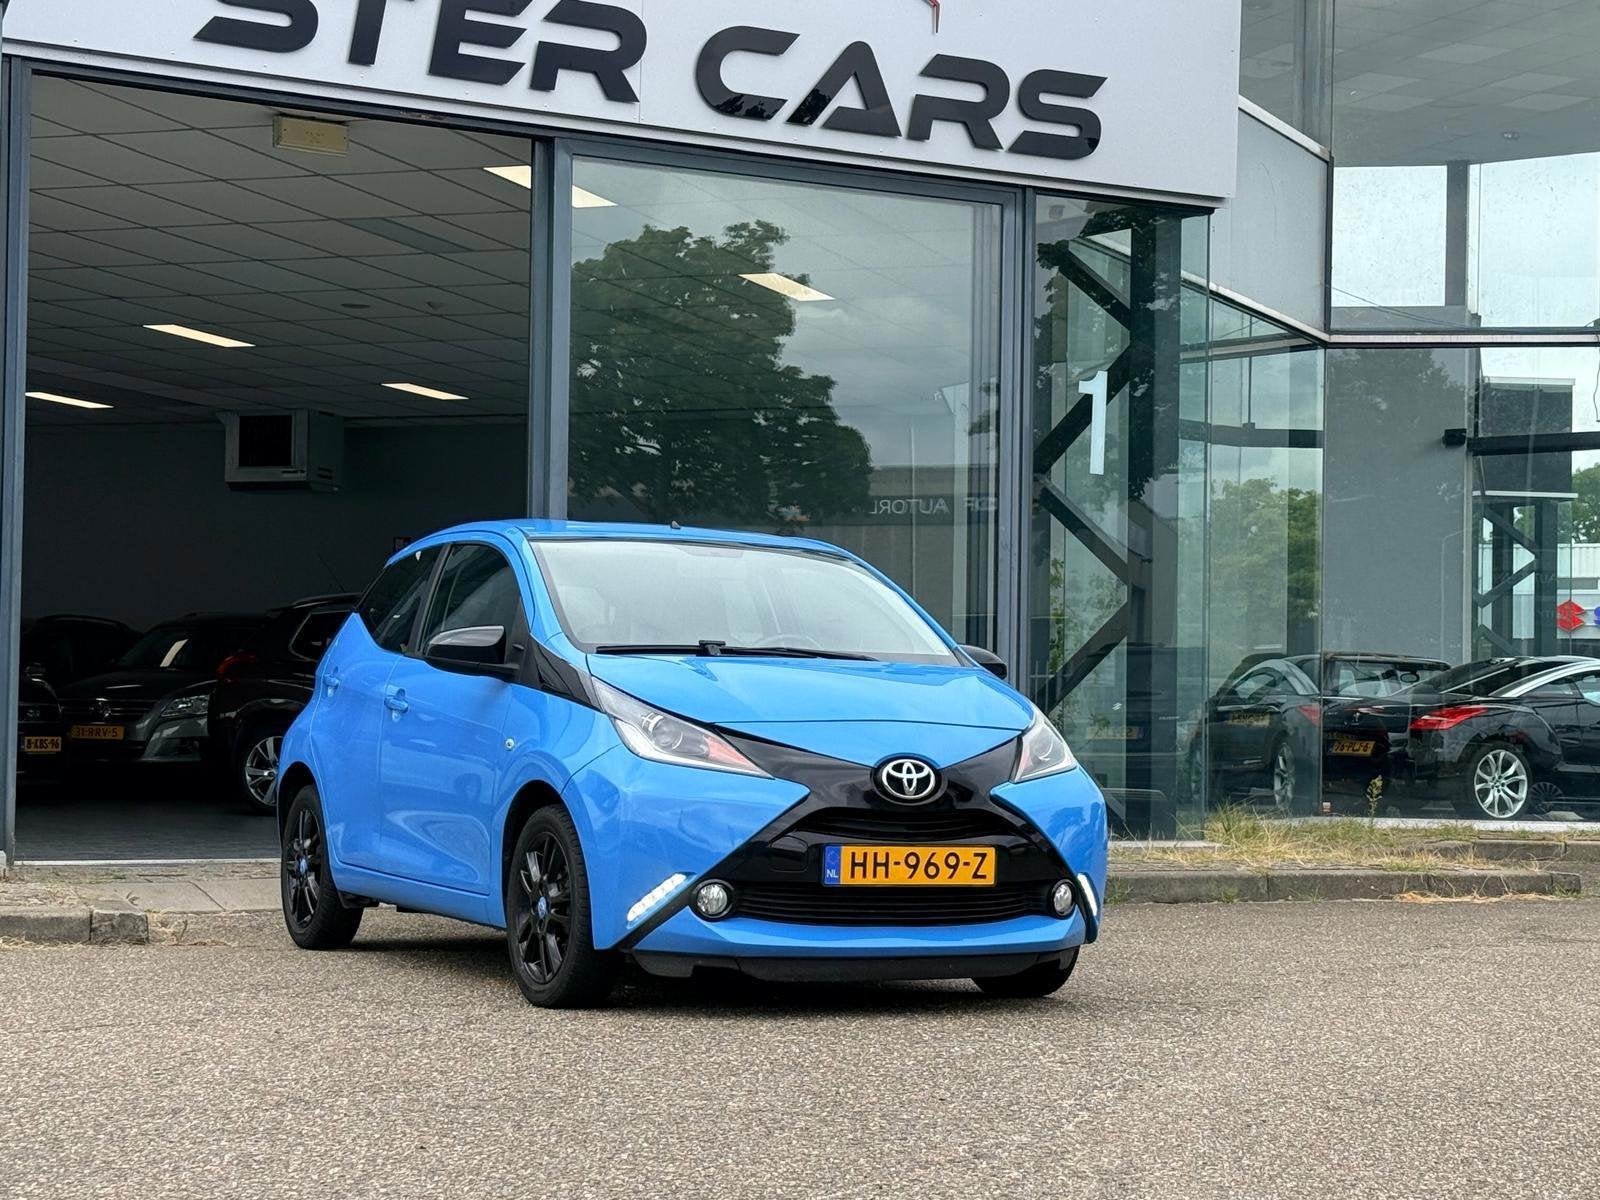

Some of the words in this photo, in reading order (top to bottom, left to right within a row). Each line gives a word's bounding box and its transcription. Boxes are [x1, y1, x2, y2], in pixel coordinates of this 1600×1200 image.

[695, 25, 1109, 161] CARS
[1078, 370, 1109, 476] 1
[826, 869, 839, 878] NL
[849, 851, 988, 880] HH-969-Z
